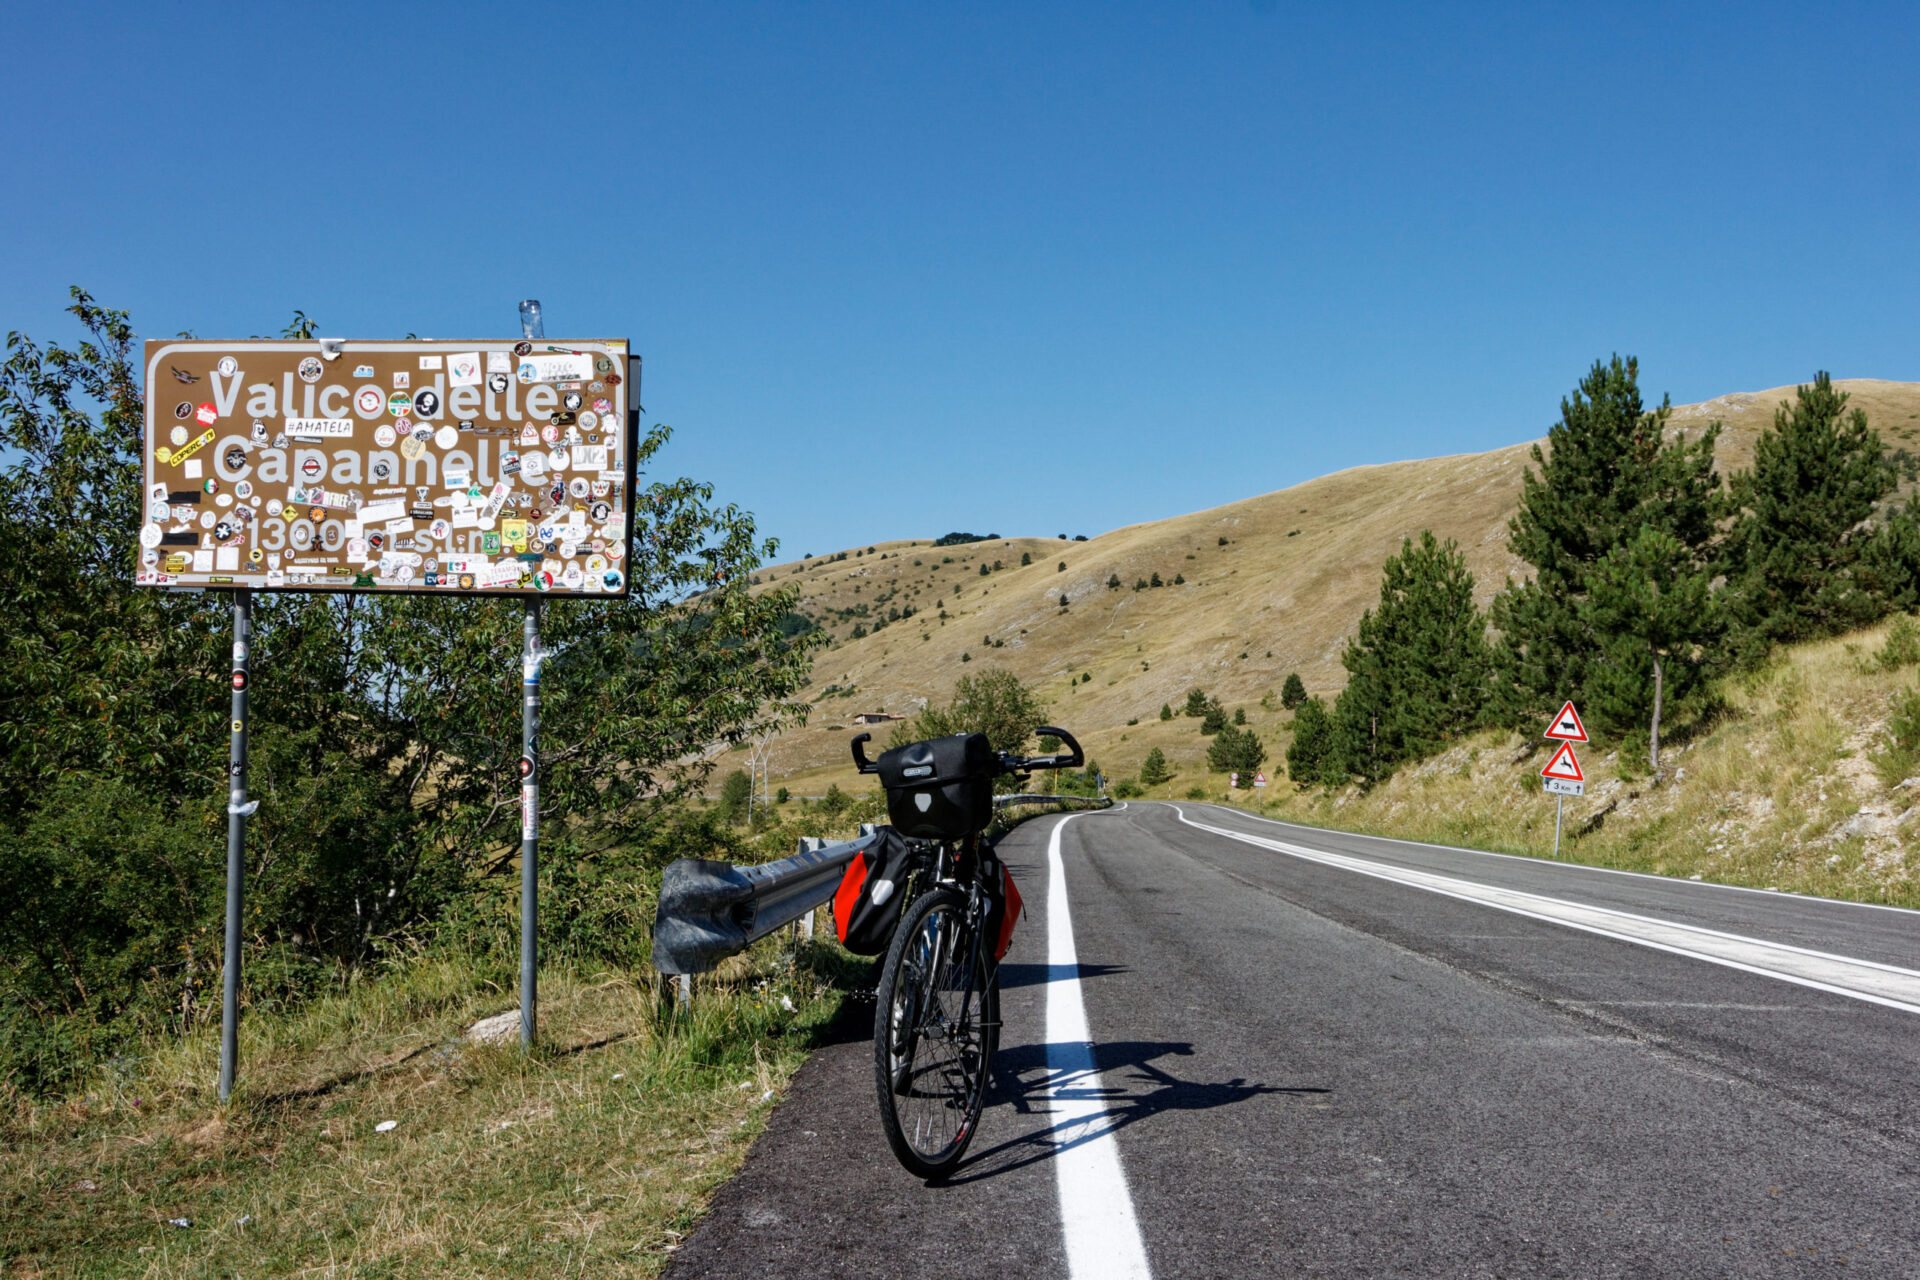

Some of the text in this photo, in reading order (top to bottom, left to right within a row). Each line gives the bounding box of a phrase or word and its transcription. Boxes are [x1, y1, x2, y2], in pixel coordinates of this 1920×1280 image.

[209, 371, 559, 421] Valico delle
[288, 421, 351, 434] #AMATELA
[213, 435, 551, 495] Capannelle
[246, 518, 345, 552] 1300
[1553, 782, 1560, 790] 3
